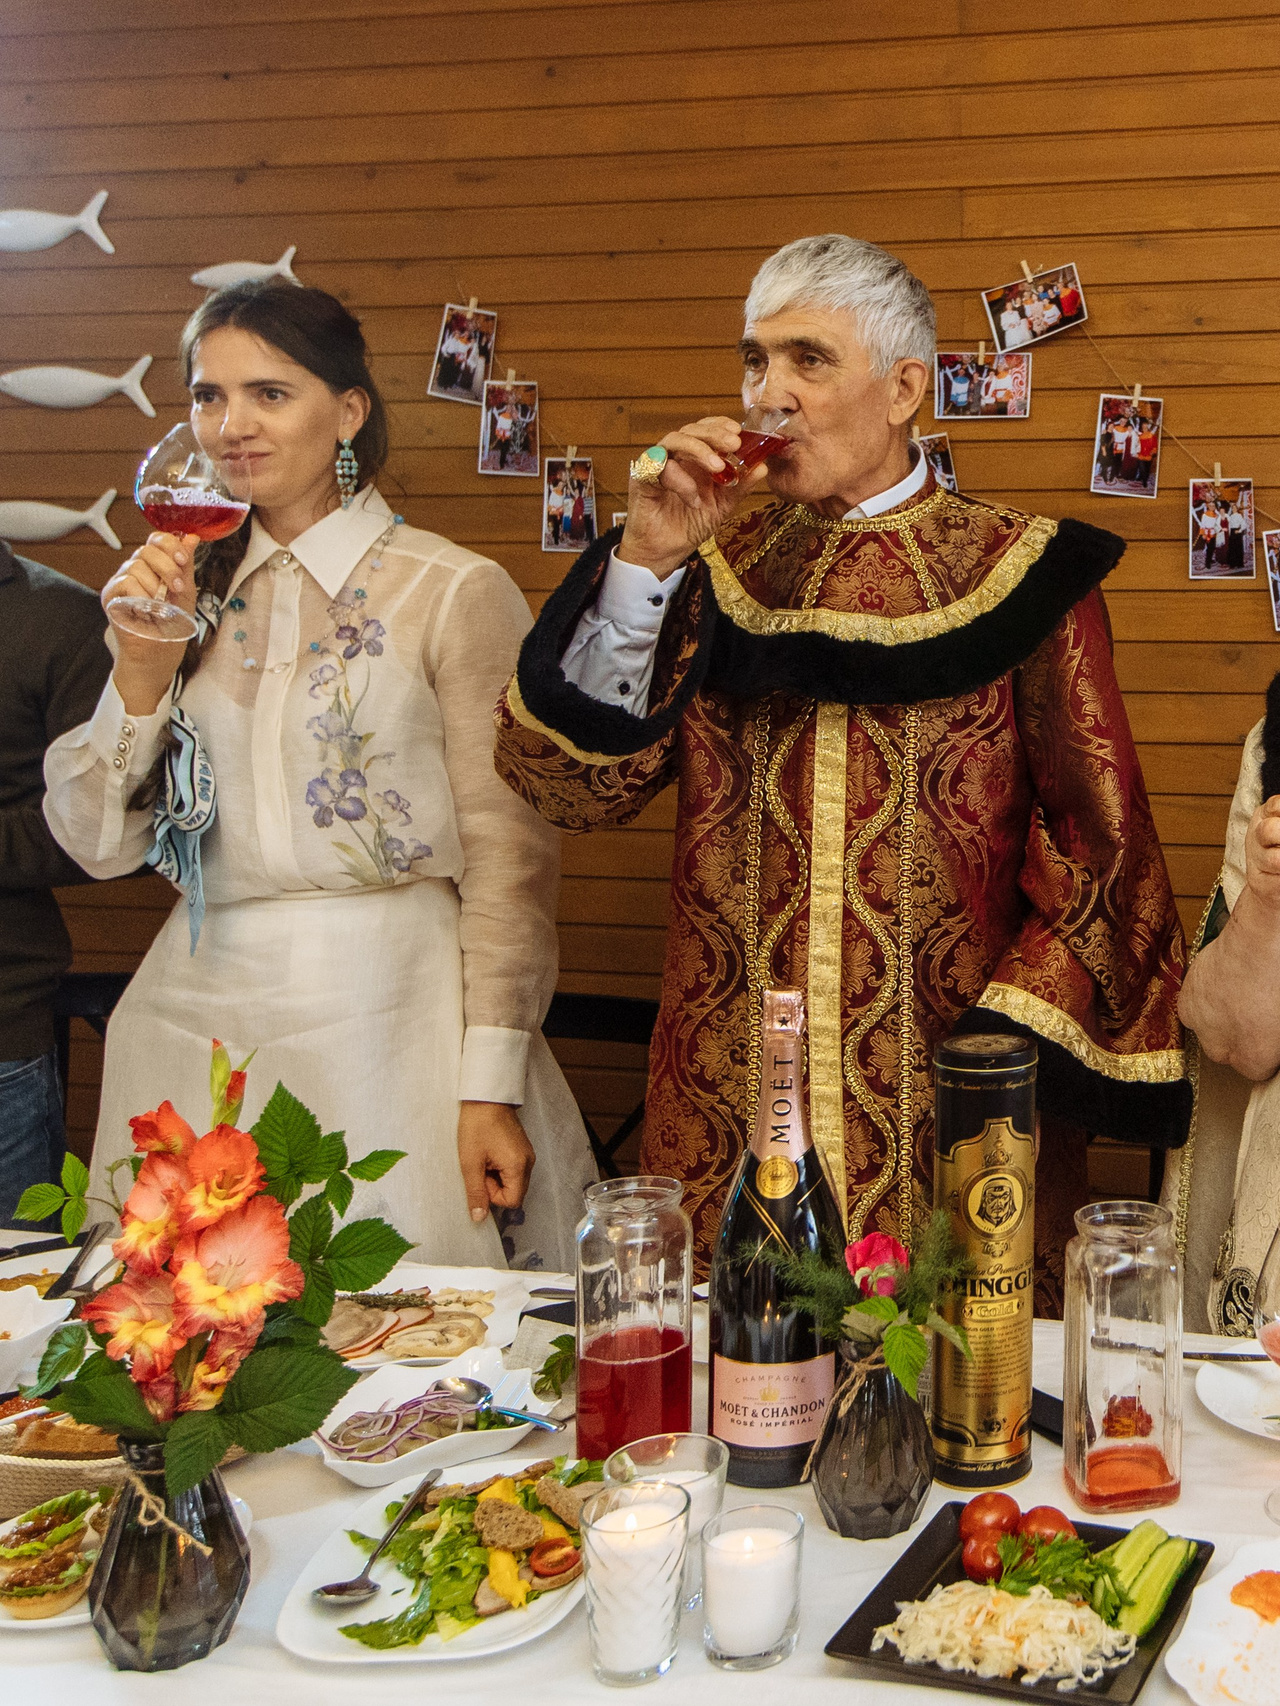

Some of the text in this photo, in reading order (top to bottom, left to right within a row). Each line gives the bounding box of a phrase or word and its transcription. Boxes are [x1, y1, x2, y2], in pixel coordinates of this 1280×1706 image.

[769, 1055, 793, 1144] MOËT
[976, 1301, 1014, 1317] Gold
[735, 1375, 807, 1383] CHAMPAGNE
[720, 1399, 749, 1417] MOËT
[751, 1409, 759, 1418] &
[761, 1398, 825, 1418] CHANDON
[730, 1416, 813, 1427] ROSÉ IMPÉRIAL
